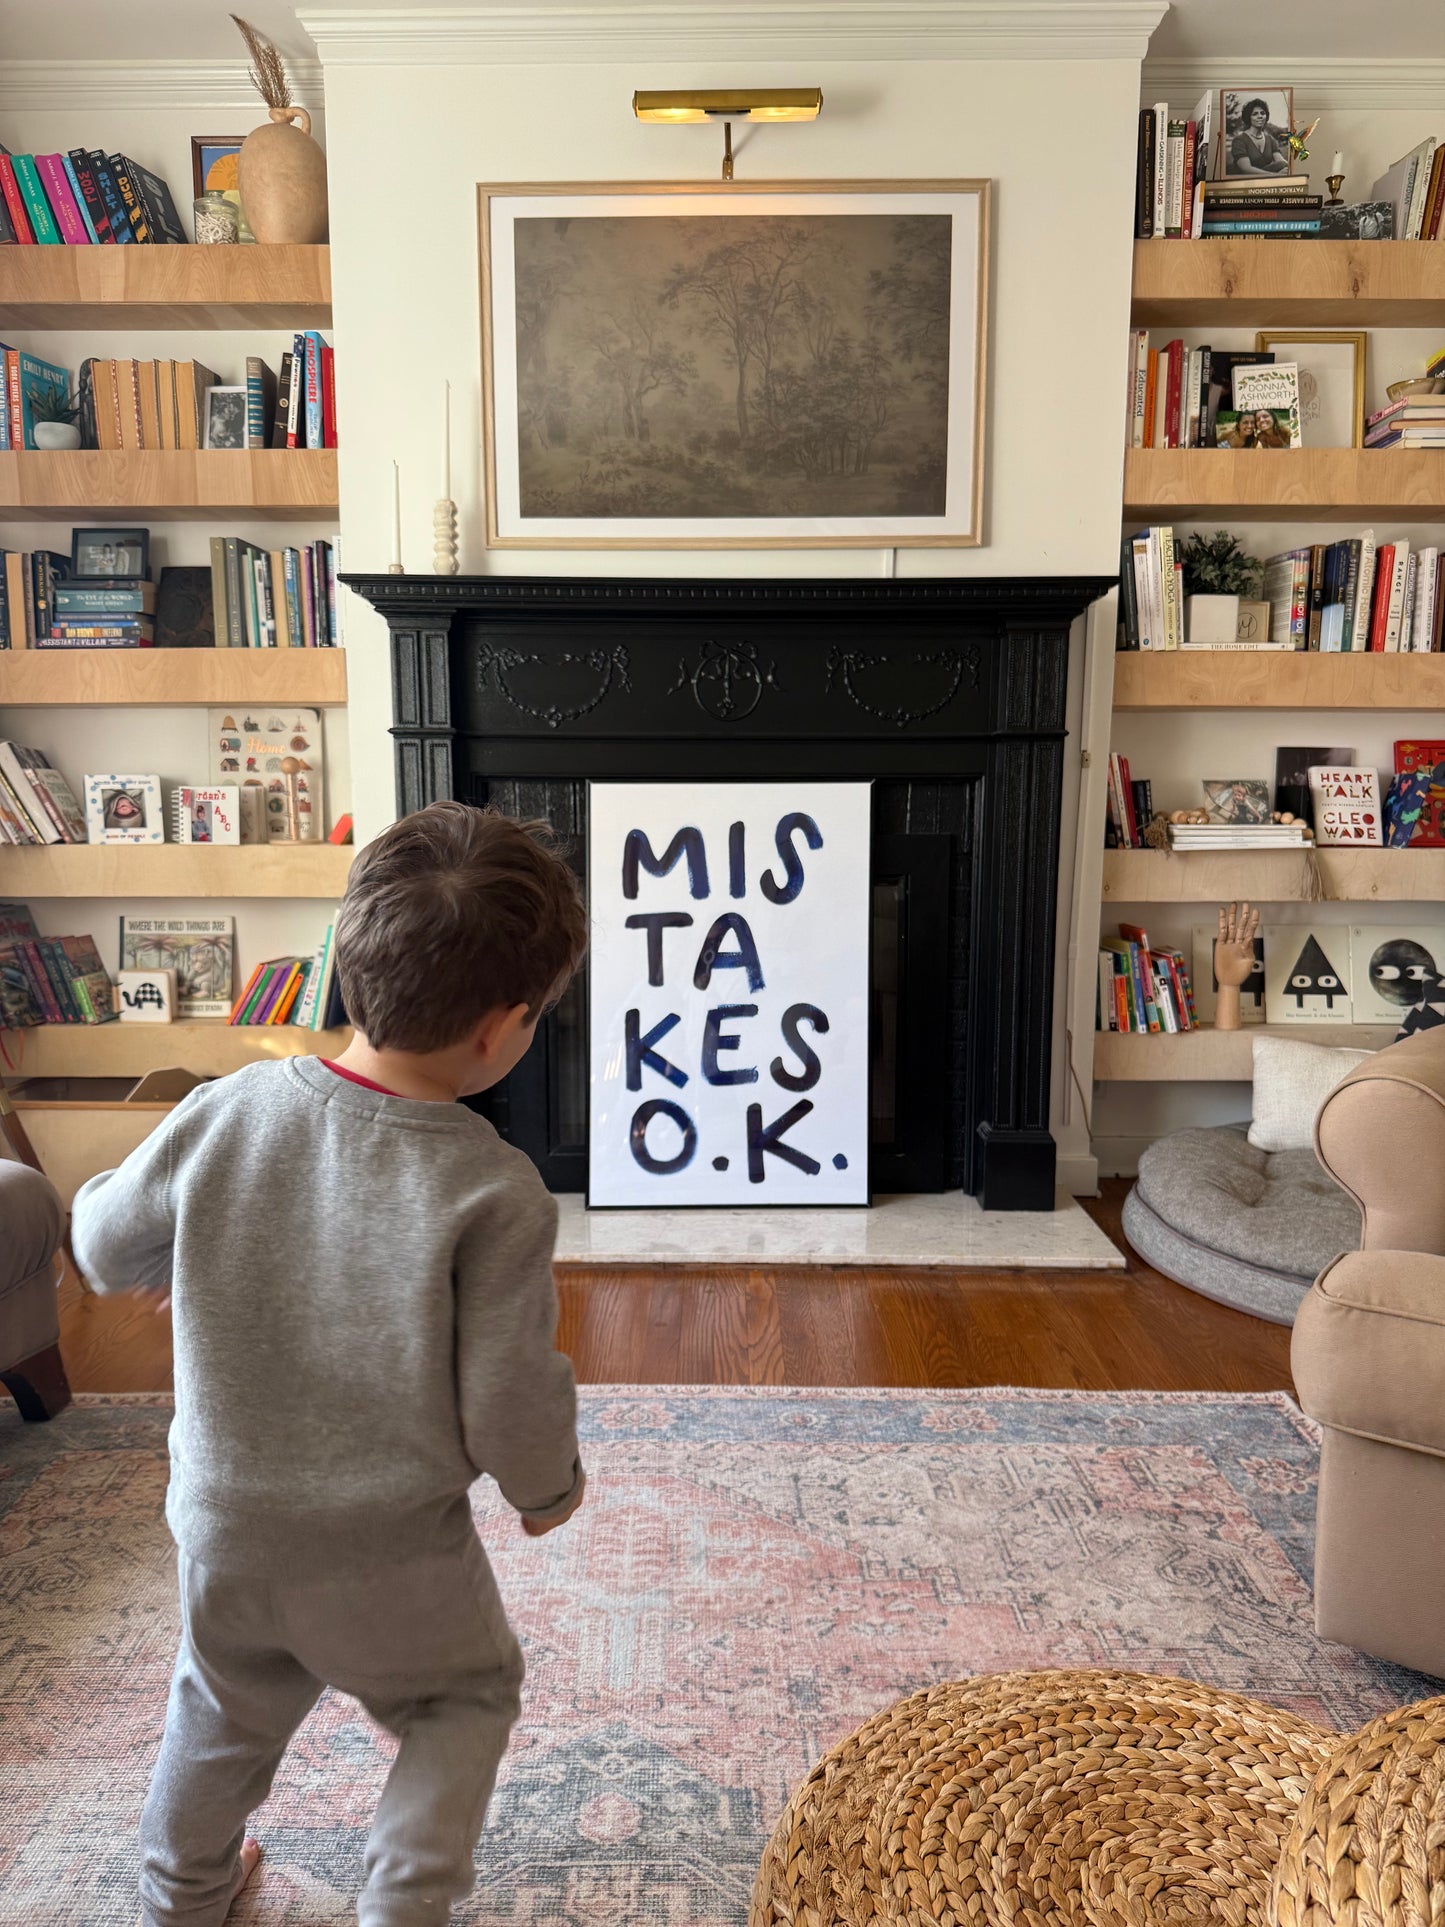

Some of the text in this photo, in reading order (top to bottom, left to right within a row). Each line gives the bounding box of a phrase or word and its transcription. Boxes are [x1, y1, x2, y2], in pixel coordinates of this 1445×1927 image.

[78, 170, 96, 203] WOOL
[98, 172, 117, 209] SHIFT
[118, 176, 134, 207] DUST
[23, 360, 64, 385] EMILY HENRY
[306, 337, 317, 404] ATMOSPHERE
[1137, 369, 1146, 417] Educated
[1240, 390, 1296, 401] ASHWORTH
[1248, 383, 1286, 392] DONNA
[1359, 555, 1373, 630] Atomic Habits
[1394, 561, 1404, 593] RANGE
[247, 736, 286, 754] Home
[1320, 773, 1372, 783] HEART
[1321, 785, 1372, 798] TALK
[196, 790, 226, 800] rdan's
[1324, 812, 1374, 825] CLEO
[1324, 827, 1376, 839] WADE
[622, 812, 824, 905] MIS
[128, 921, 225, 931] WHERE THE WILD THINGS ARE
[624, 912, 766, 994] TA
[624, 1002, 830, 1093] KES
[629, 1097, 849, 1184] O.K.
